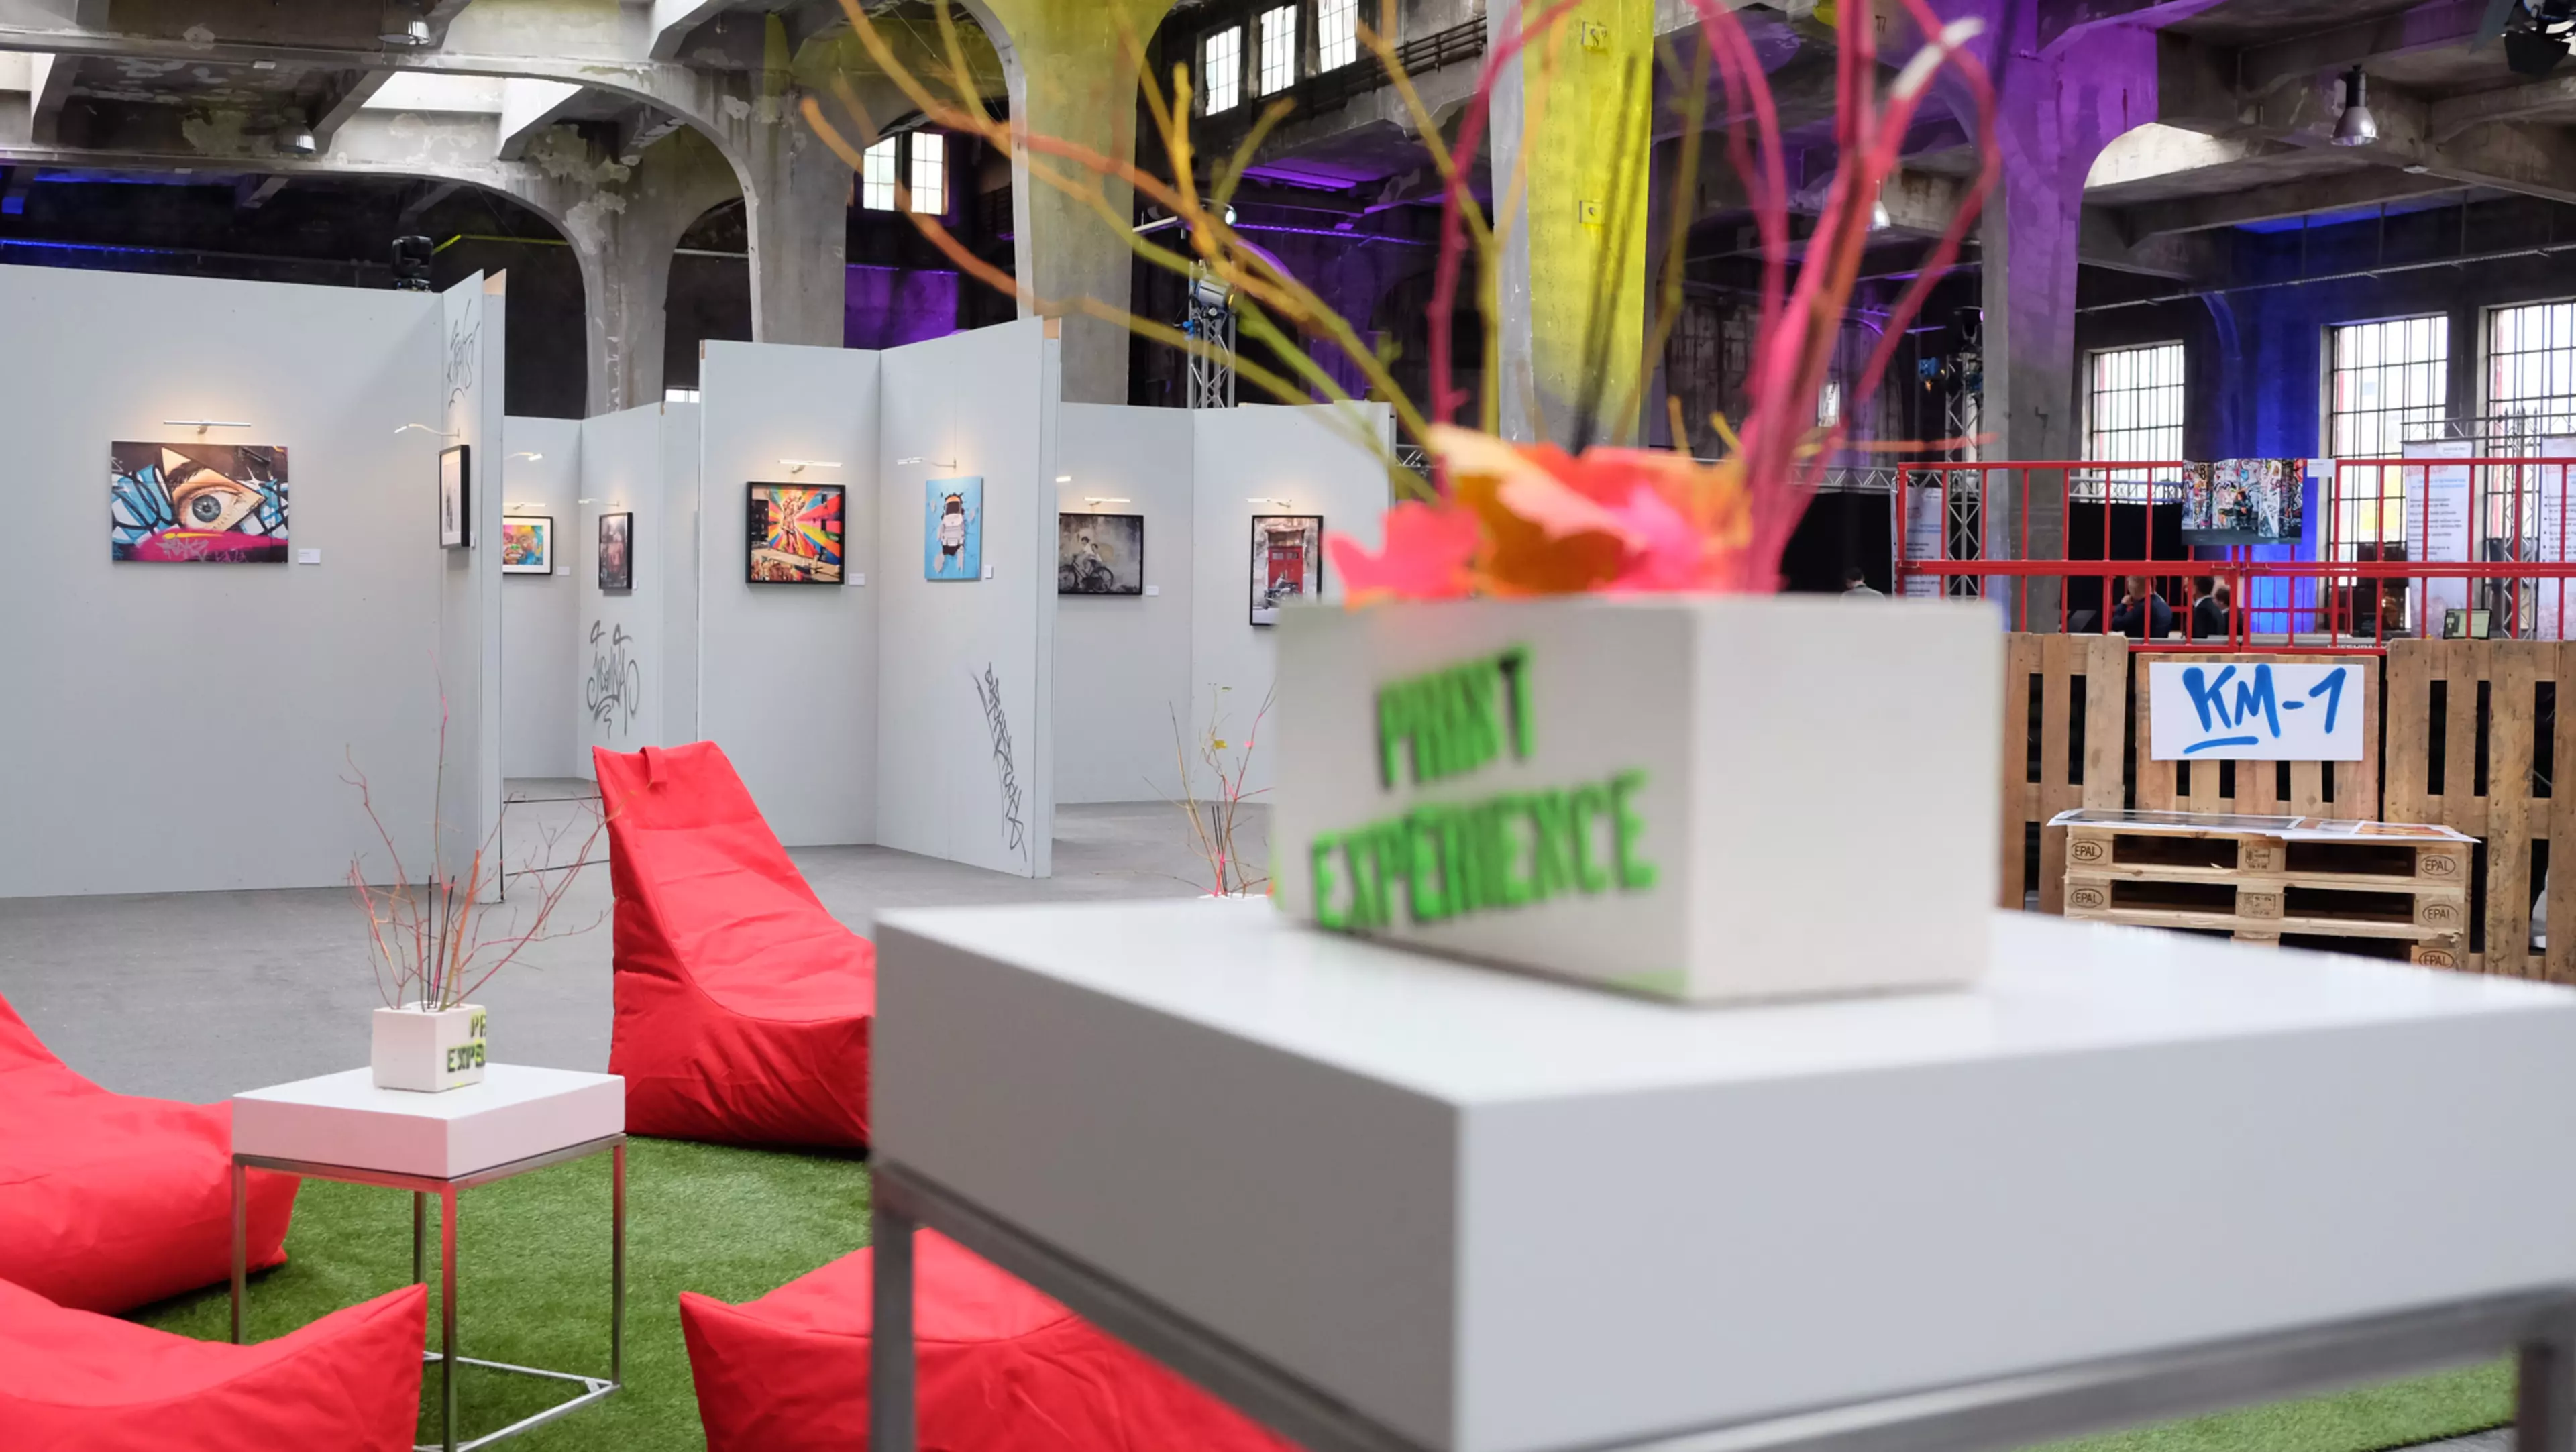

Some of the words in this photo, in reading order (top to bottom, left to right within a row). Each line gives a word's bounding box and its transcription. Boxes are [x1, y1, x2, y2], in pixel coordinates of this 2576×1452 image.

[2182, 663, 2347, 738] KM-1
[2074, 845, 2098, 856] EPAL
[2424, 859, 2449, 871] EPAL
[2076, 893, 2098, 904] EPAL
[2424, 956, 2449, 966] EPAL
